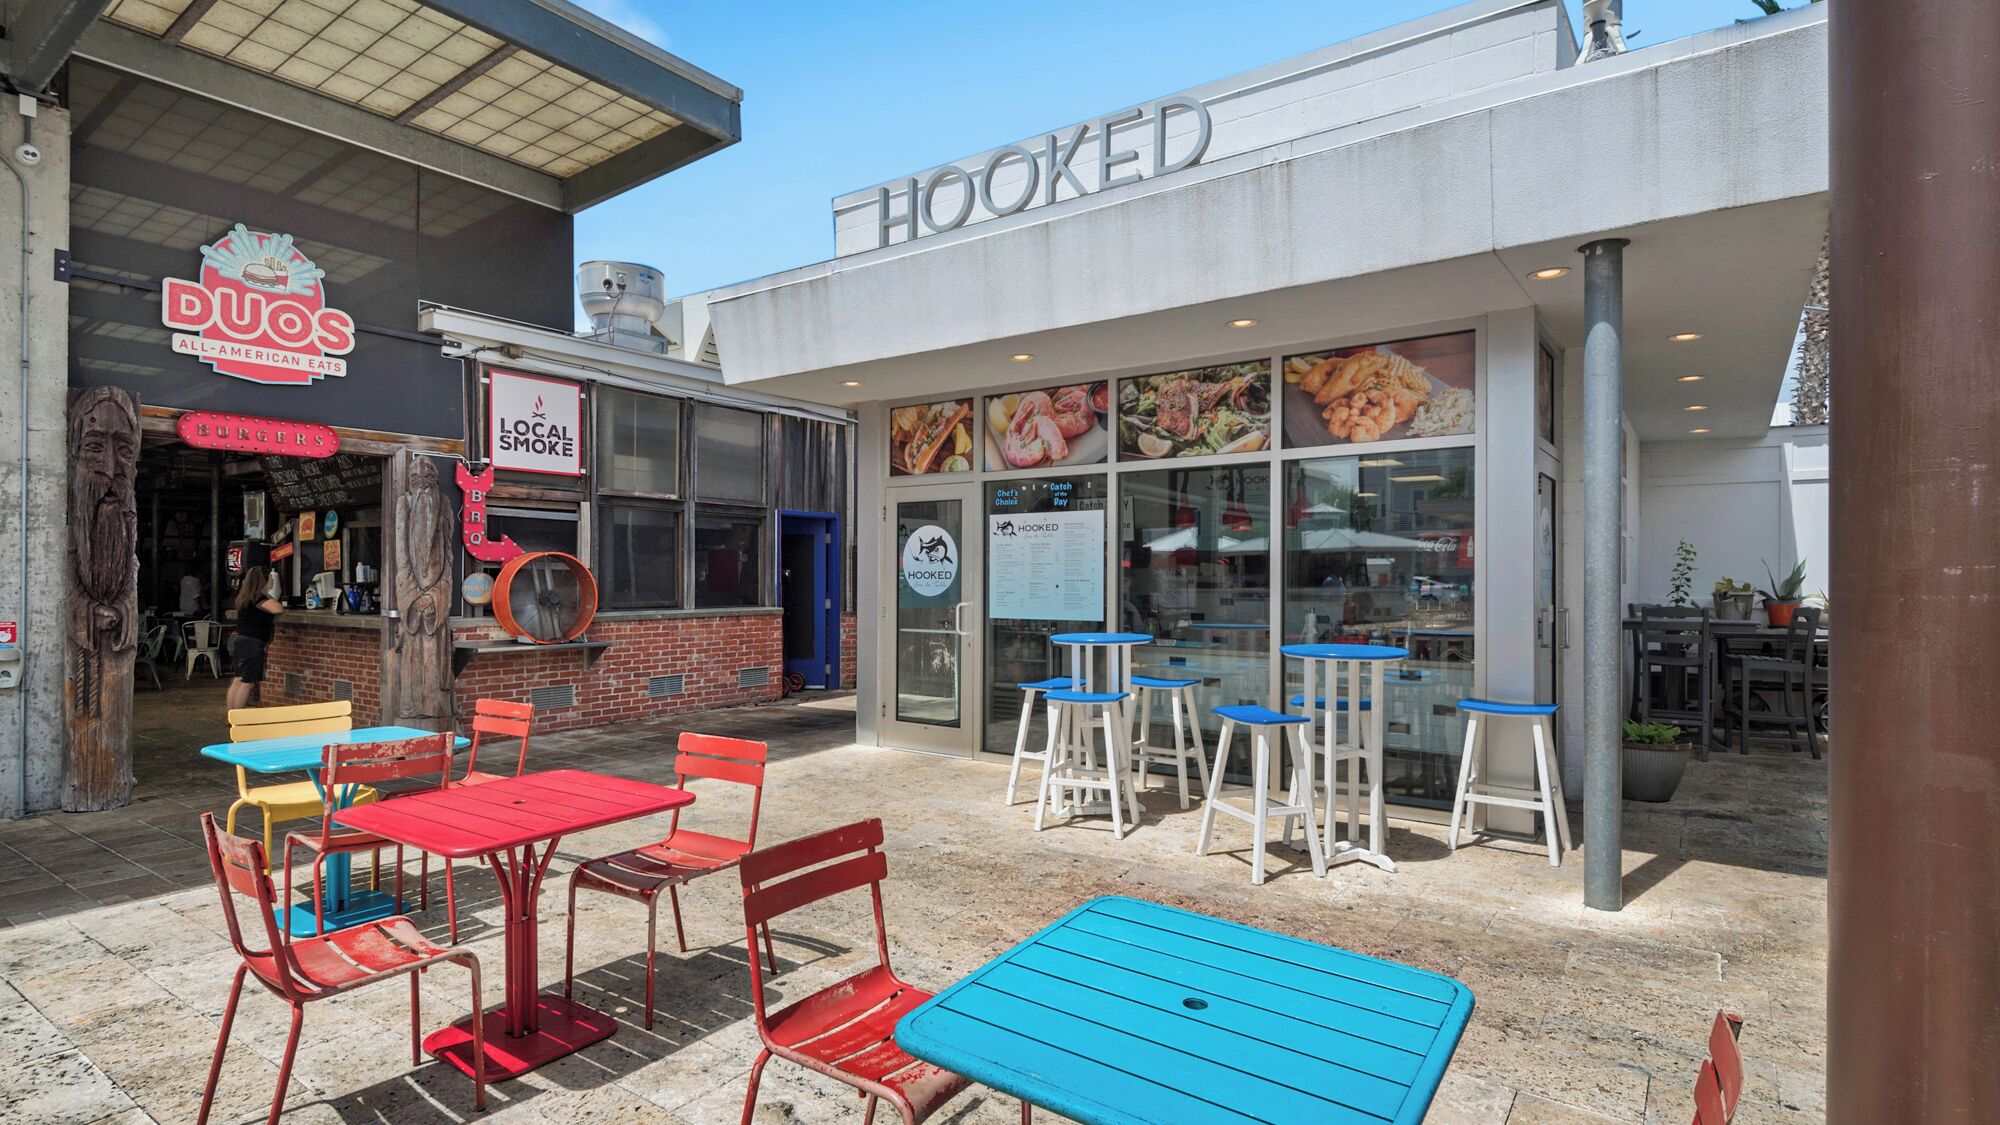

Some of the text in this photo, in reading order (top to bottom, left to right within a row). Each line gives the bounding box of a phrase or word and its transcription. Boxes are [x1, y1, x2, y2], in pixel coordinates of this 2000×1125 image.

[879, 95, 1212, 248] HOOKED
[165, 279, 353, 353] DUOS
[178, 338, 341, 372] ALL-AMERICAN EATS
[197, 424, 324, 447] BURGERS
[500, 417, 573, 442] LOCAL
[500, 434, 573, 457] SMOKE
[997, 489, 1018, 497] Chef's
[1050, 482, 1072, 491] Catch
[995, 498, 1018, 506] Choice
[1054, 498, 1068, 507] Day
[470, 489, 483, 545] BBQ
[1018, 523, 1059, 532] HOOKED
[908, 571, 952, 580] HOOKED
